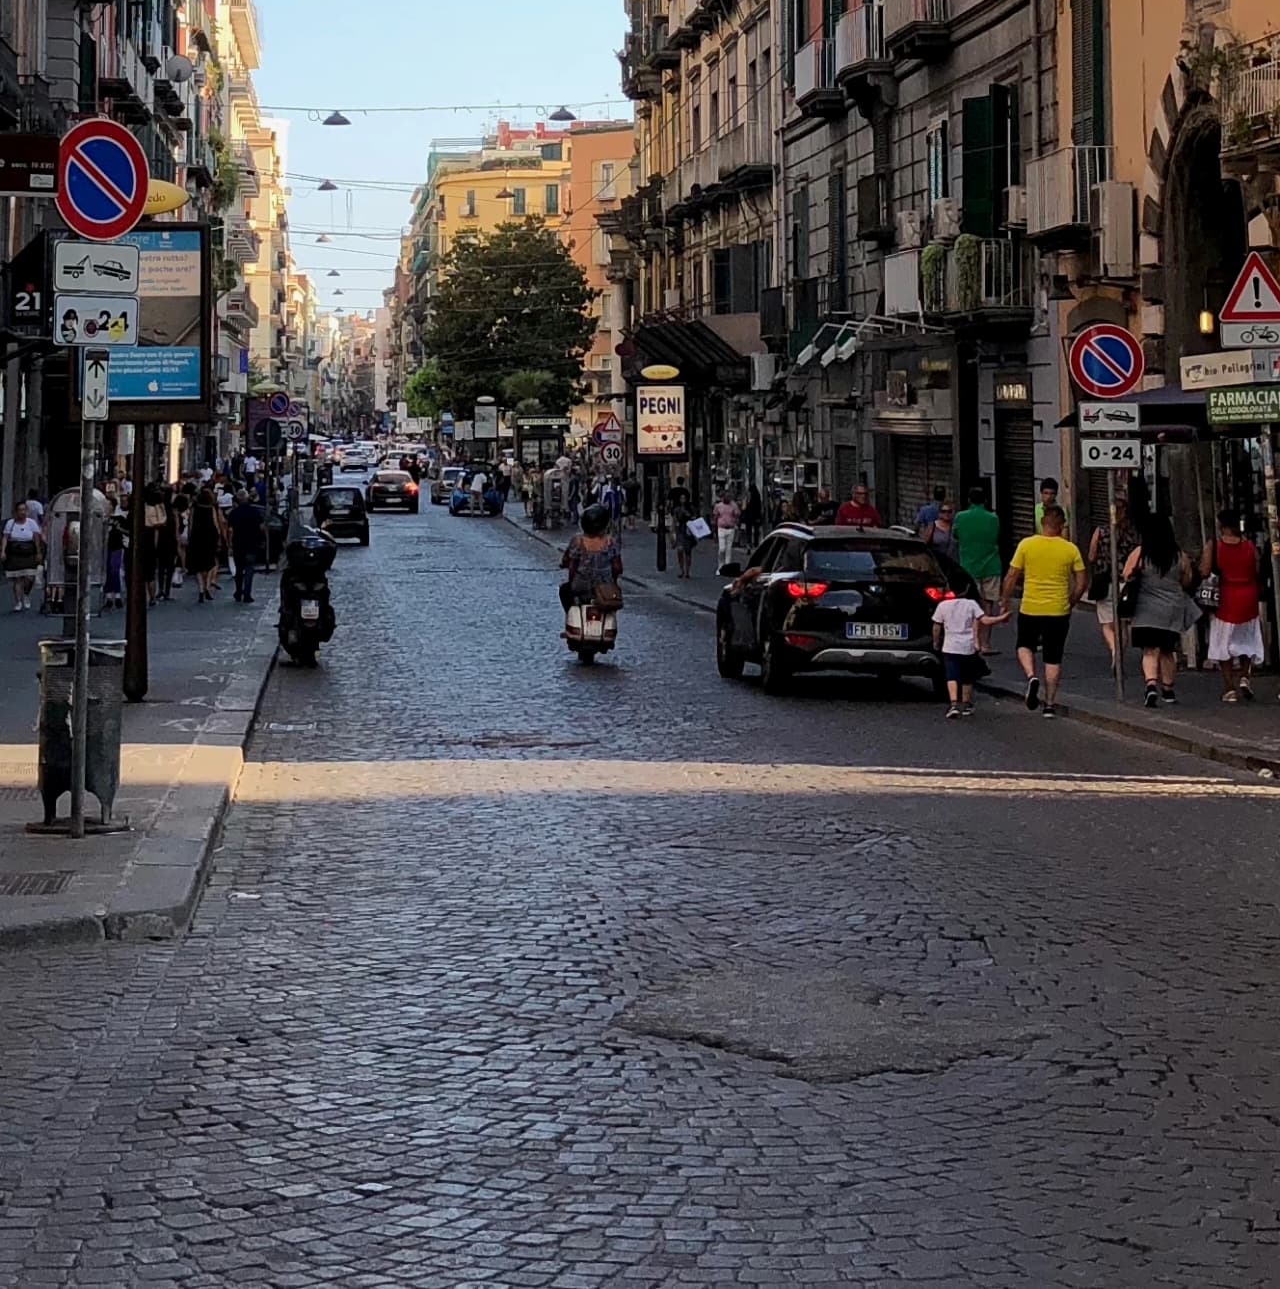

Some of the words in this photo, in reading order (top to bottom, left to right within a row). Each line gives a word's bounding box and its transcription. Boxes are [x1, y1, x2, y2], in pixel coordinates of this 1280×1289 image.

[14, 291, 42, 311] 21
[639, 397, 681, 415] PEGNI
[1209, 390, 1279, 407] FARMACIA
[606, 447, 621, 459] 30
